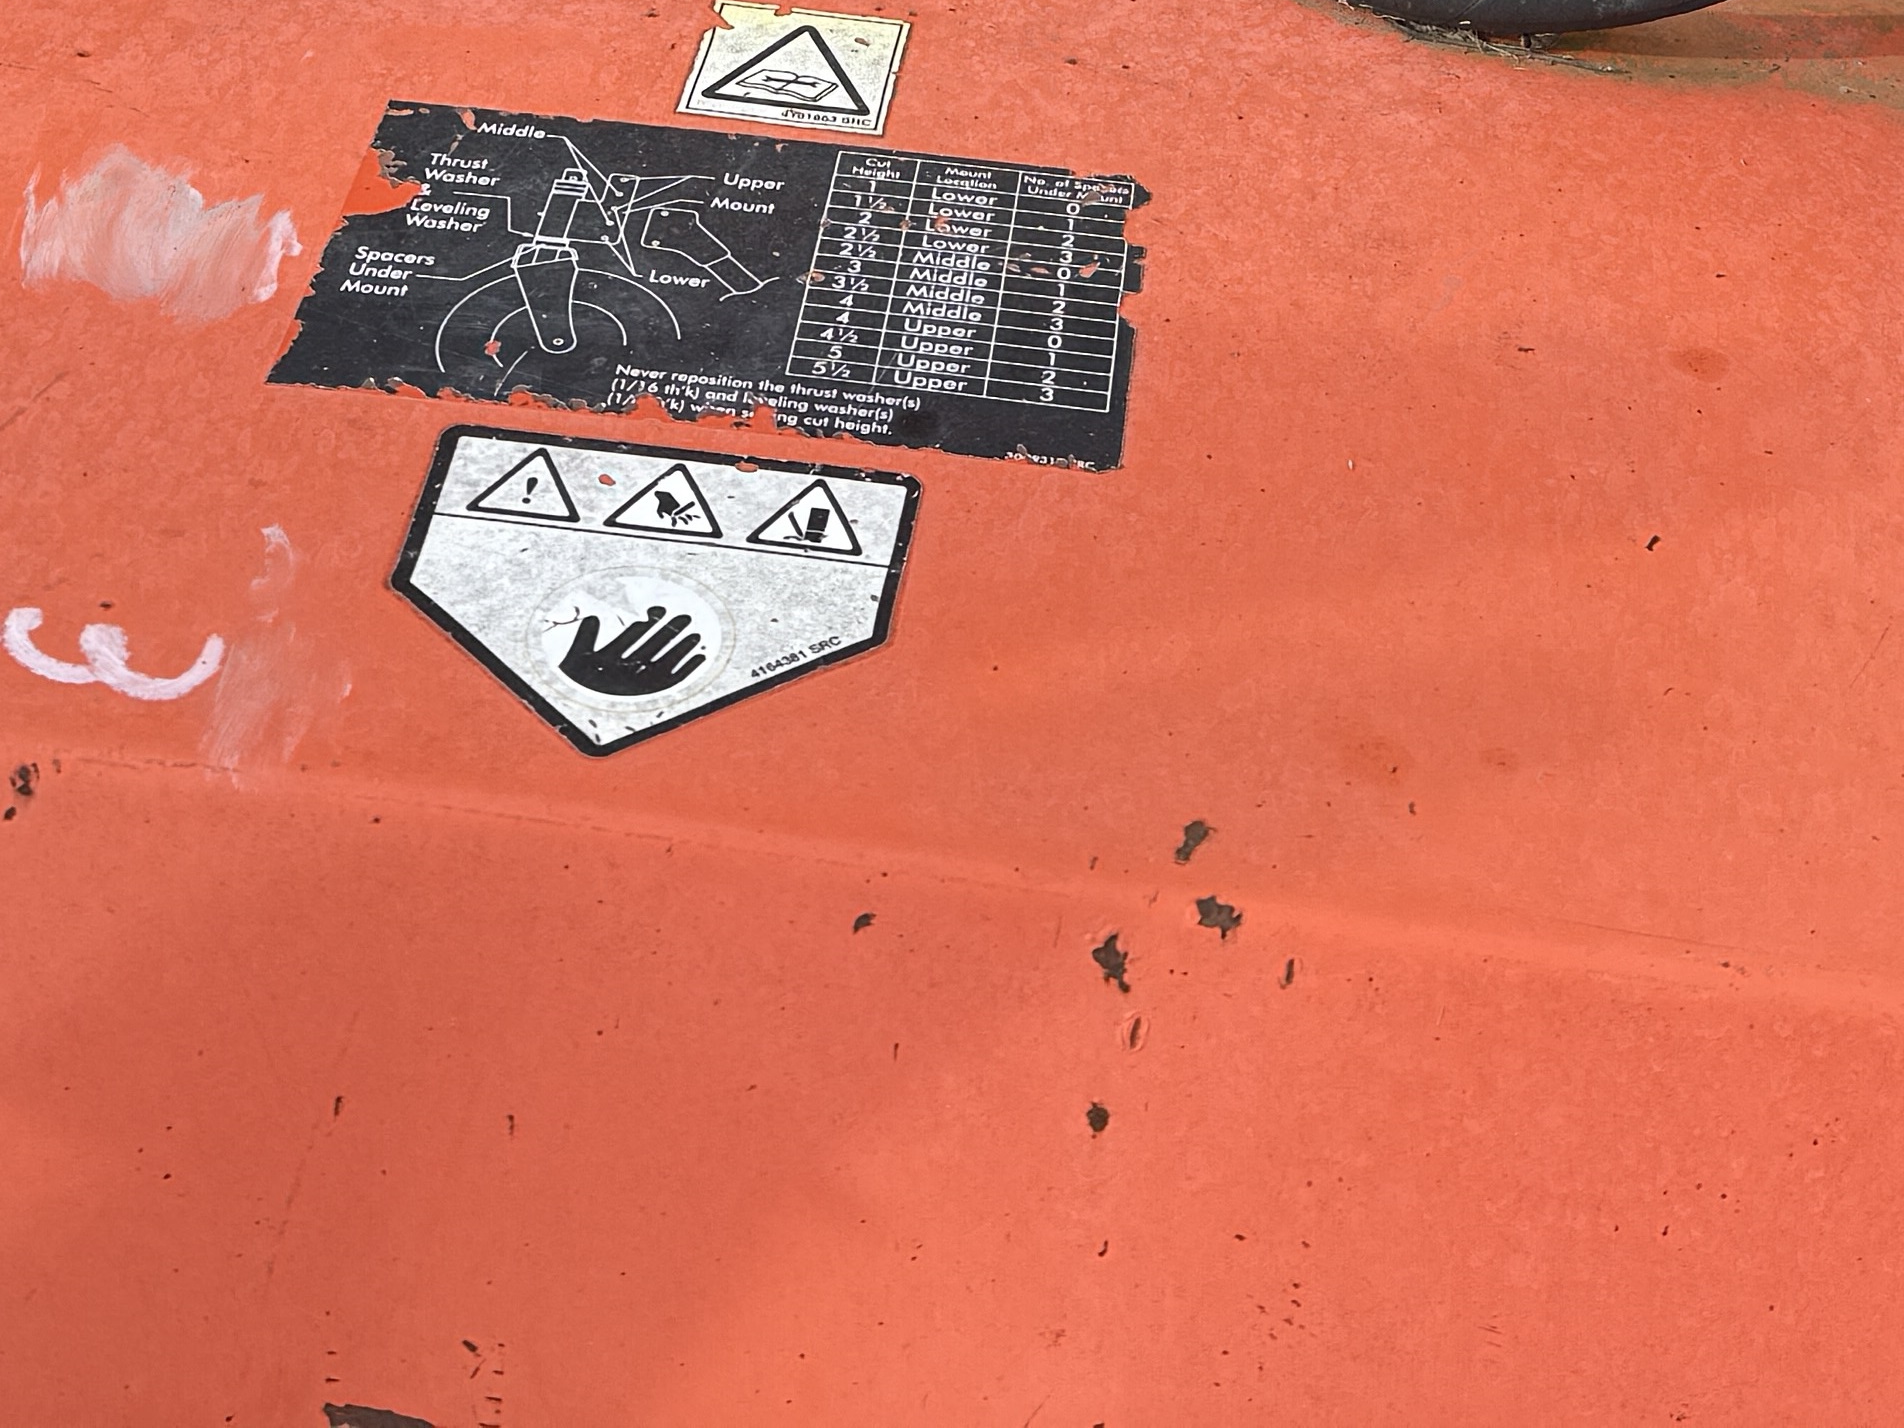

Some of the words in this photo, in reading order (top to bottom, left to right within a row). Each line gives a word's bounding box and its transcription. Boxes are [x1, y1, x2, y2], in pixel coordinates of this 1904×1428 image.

[477, 122, 546, 139] Middle
[431, 152, 488, 169] Thrust
[865, 157, 892, 169] Cut
[425, 167, 500, 187] Washer
[723, 172, 785, 191] Upper
[852, 166, 900, 180] Height
[944, 167, 992, 180] Mount
[421, 183, 431, 195] &
[869, 180, 876, 192] 1
[936, 175, 997, 190] Location
[1055, 179, 1070, 188] of
[932, 187, 998, 205] Lower
[1027, 185, 1072, 198] Under
[1076, 191, 1123, 204] Munt
[410, 198, 490, 220] Leveling
[710, 196, 776, 214] Mount
[929, 202, 995, 221] Lower
[1066, 203, 1080, 215] 0
[406, 214, 483, 233] Washer
[859, 211, 872, 225] 2
[1067, 218, 1074, 231] 1
[925, 218, 992, 237] Lower
[922, 234, 990, 253] Lower
[1061, 234, 1075, 248] 2
[354, 245, 436, 266] Spacers
[913, 251, 991, 271] Middle
[1059, 251, 1073, 264] 3
[348, 262, 413, 280] Under
[847, 260, 862, 273] 3
[1057, 267, 1071, 280] 0
[649, 269, 711, 288] Lower
[909, 267, 988, 287] Middle
[339, 279, 409, 297] Mount
[906, 284, 985, 304] Middle
[1057, 284, 1065, 297] 1
[839, 294, 854, 307] 4
[1052, 300, 1066, 314] 2
[836, 311, 850, 324] 4
[902, 301, 982, 321] Middle
[904, 317, 976, 338] Upper
[1049, 317, 1064, 331] 3
[901, 335, 974, 356] Upper
[1047, 335, 1063, 349] 0
[827, 345, 843, 359] 5
[1048, 352, 1056, 366] 1
[897, 352, 971, 373] Upper
[894, 370, 968, 391] Upper
[1041, 370, 1056, 385] 2
[615, 363, 667, 379] Never
[671, 371, 753, 389] reposition
[758, 379, 785, 393] the
[790, 383, 838, 399] thrust
[842, 391, 921, 411] washer(s)
[1039, 387, 1054, 402] 3
[705, 390, 739, 403] and
[814, 404, 894, 422] washer(s)
[803, 415, 829, 427] cut
[834, 419, 893, 435] height.
[809, 635, 842, 654] SRC
